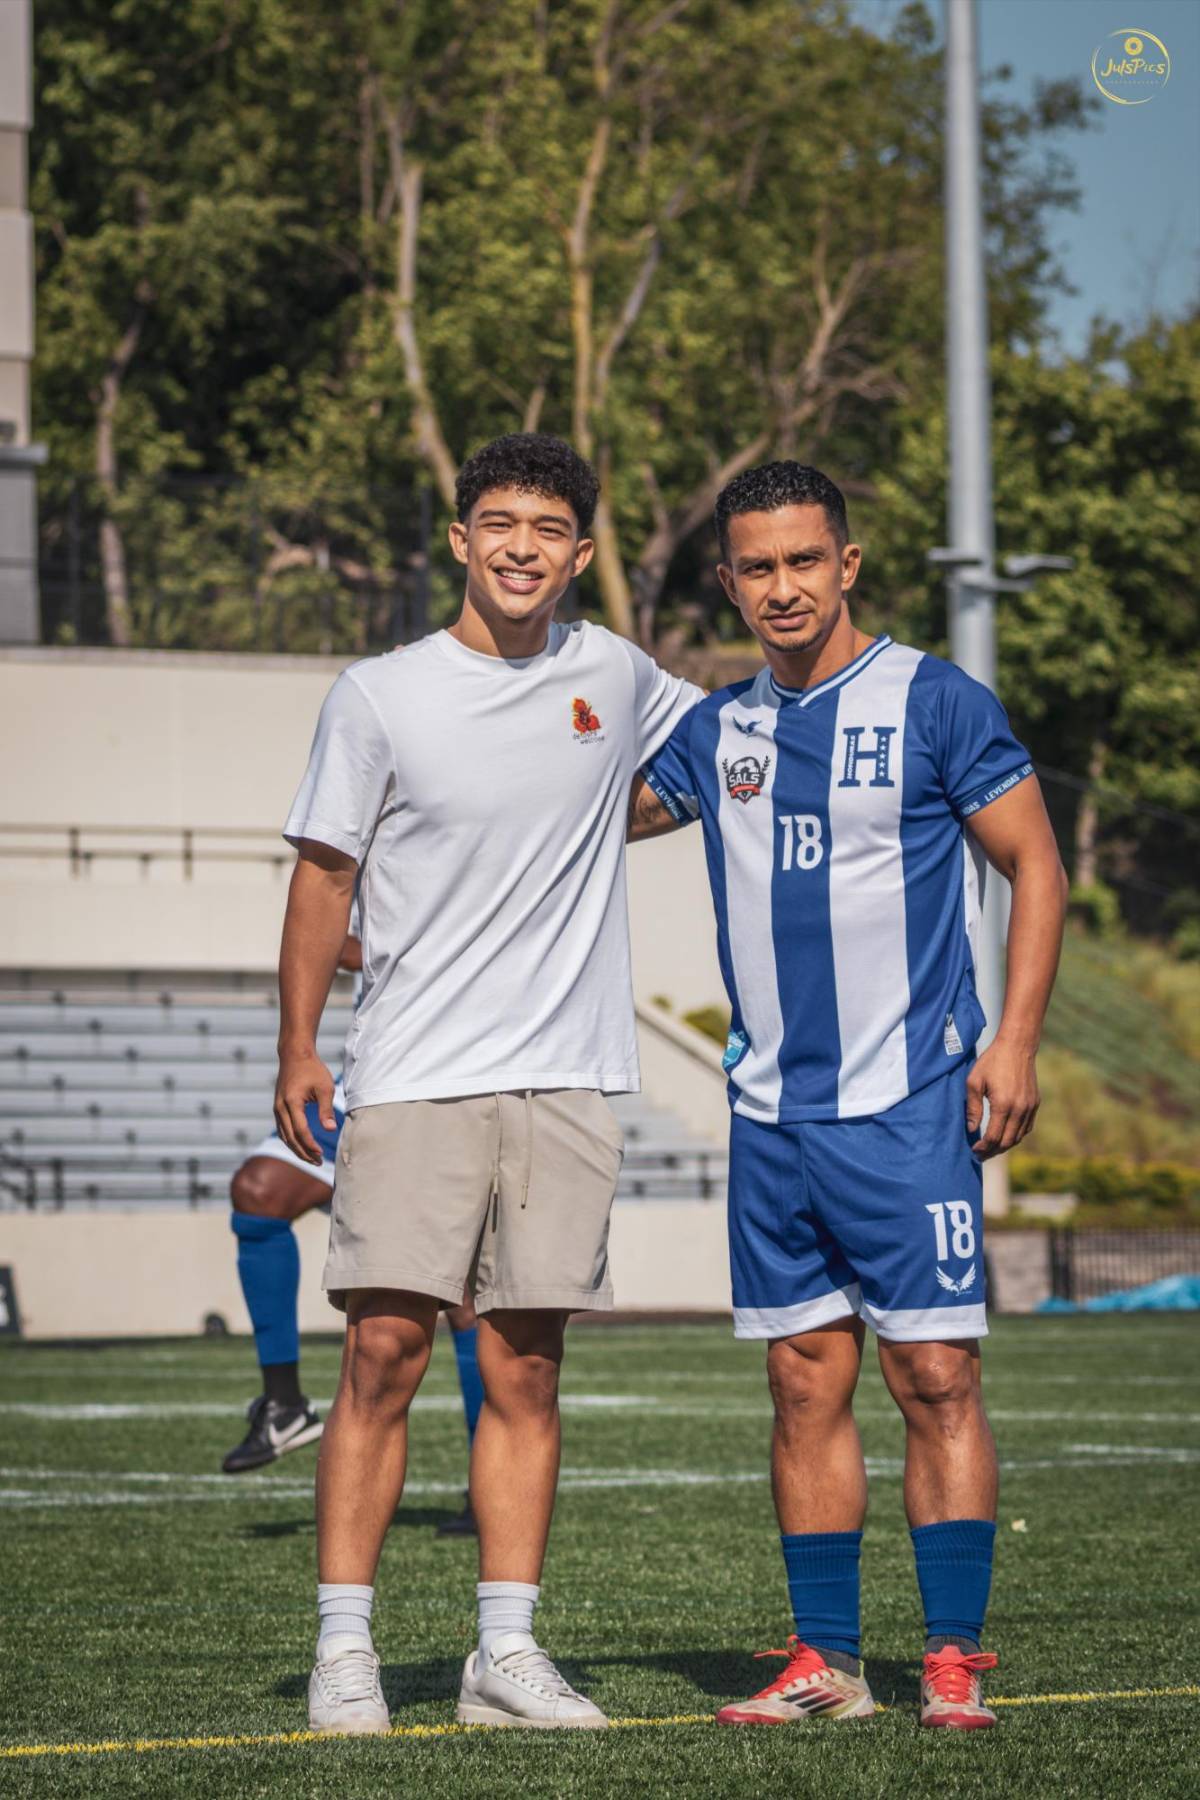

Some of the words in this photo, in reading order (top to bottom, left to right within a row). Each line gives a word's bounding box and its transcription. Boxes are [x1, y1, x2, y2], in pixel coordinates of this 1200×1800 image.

[728, 772, 760, 788] SALS
[838, 726, 897, 788] H
[984, 773, 1020, 802] LEYENDAS
[778, 814, 824, 871] 18
[924, 1200, 976, 1261] 18
